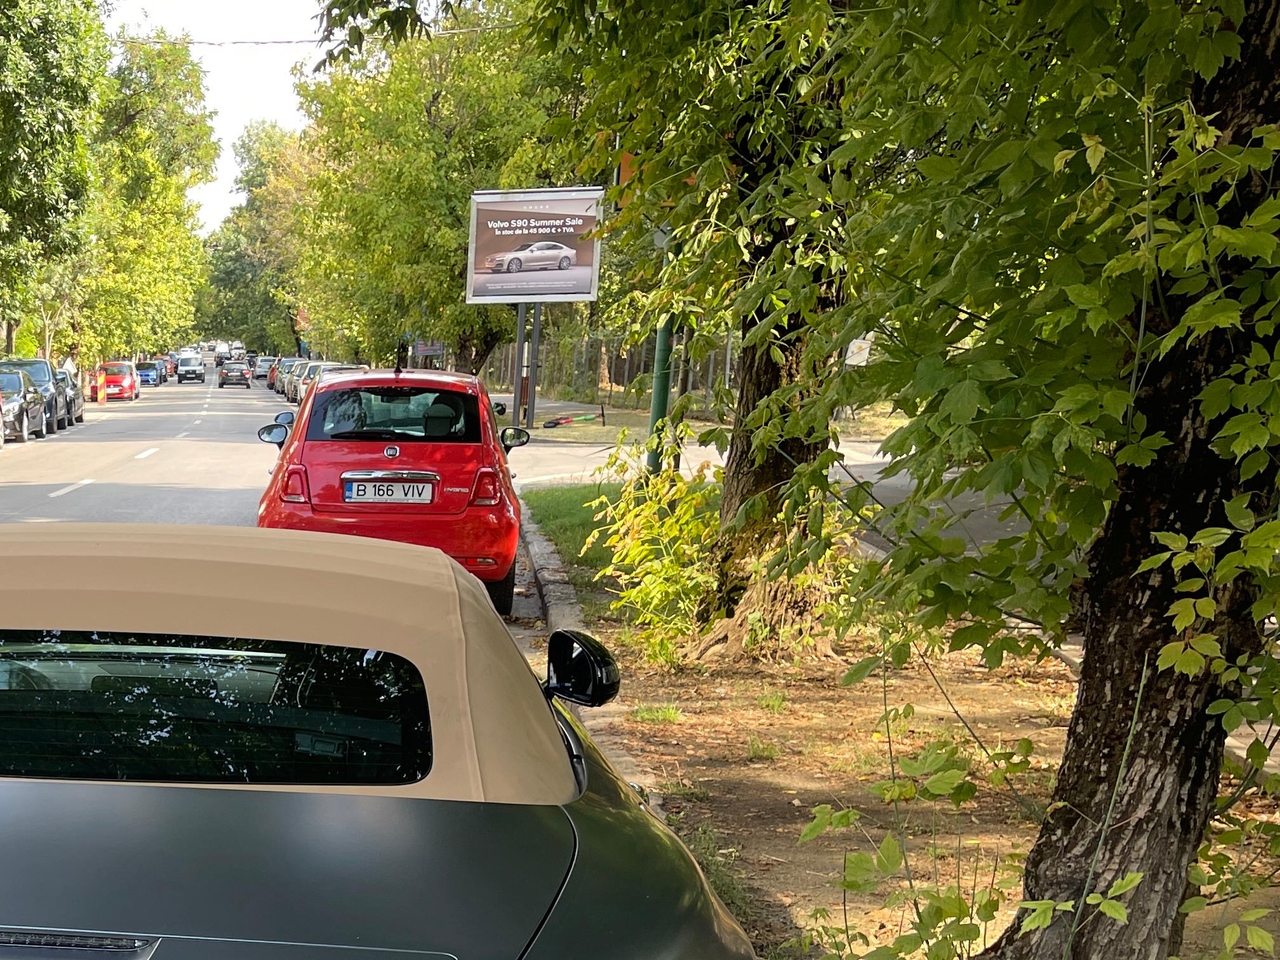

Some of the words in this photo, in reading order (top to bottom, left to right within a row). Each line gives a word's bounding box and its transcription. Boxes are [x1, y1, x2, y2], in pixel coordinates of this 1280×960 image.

[487, 219, 509, 229] Volvo
[510, 218, 528, 228] S90
[529, 218, 564, 227] Summer
[565, 217, 584, 226] Sale
[356, 484, 367, 497] B
[372, 484, 394, 497] 166
[402, 485, 426, 498] VIV
